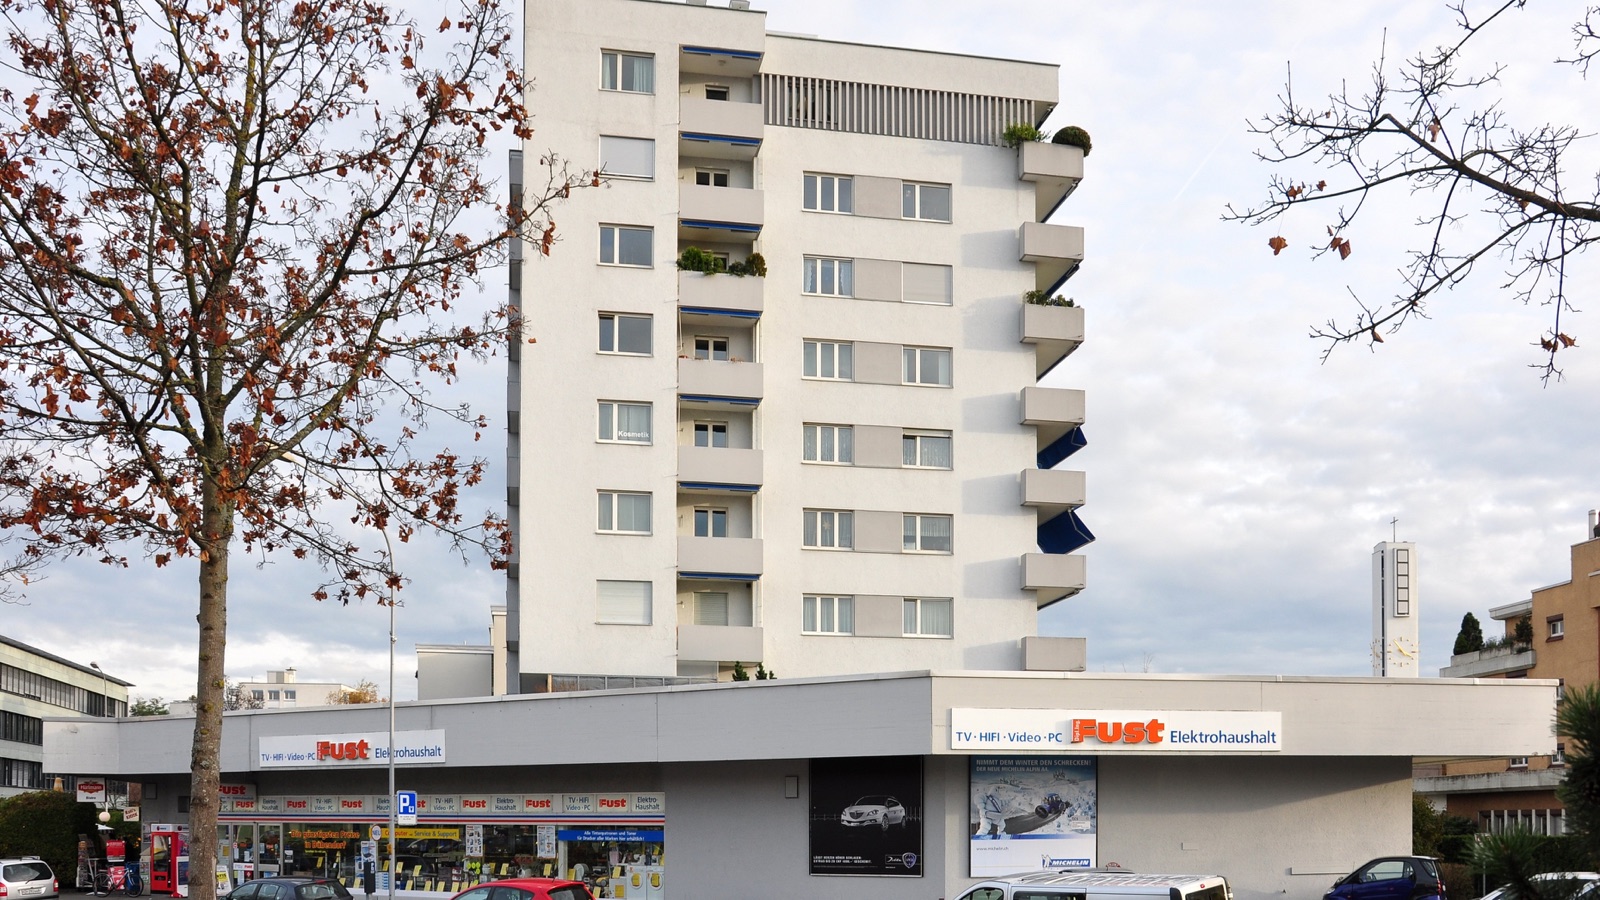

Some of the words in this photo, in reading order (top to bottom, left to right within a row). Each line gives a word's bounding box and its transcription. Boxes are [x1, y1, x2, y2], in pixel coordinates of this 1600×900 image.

[618, 430, 650, 438] Kosmetik
[1070, 718, 1165, 744] Fust
[956, 732, 972, 742] TV
[979, 732, 1000, 742] HIFI
[1008, 732, 1042, 743] Video
[1049, 732, 1063, 742] PC
[1170, 730, 1277, 744] Elektrohaushalt
[317, 739, 369, 761] Fust
[261, 754, 270, 762] TV
[273, 753, 284, 761] HIFI
[287, 752, 305, 761] Video
[307, 752, 316, 760] PC
[341, 800, 363, 808] Fust
[400, 795, 410, 813] P
[463, 800, 487, 808] Fust
[525, 799, 551, 808] Fust
[599, 798, 627, 808] Fust
[635, 803, 660, 811] Haushalt
[438, 830, 457, 838] Support
